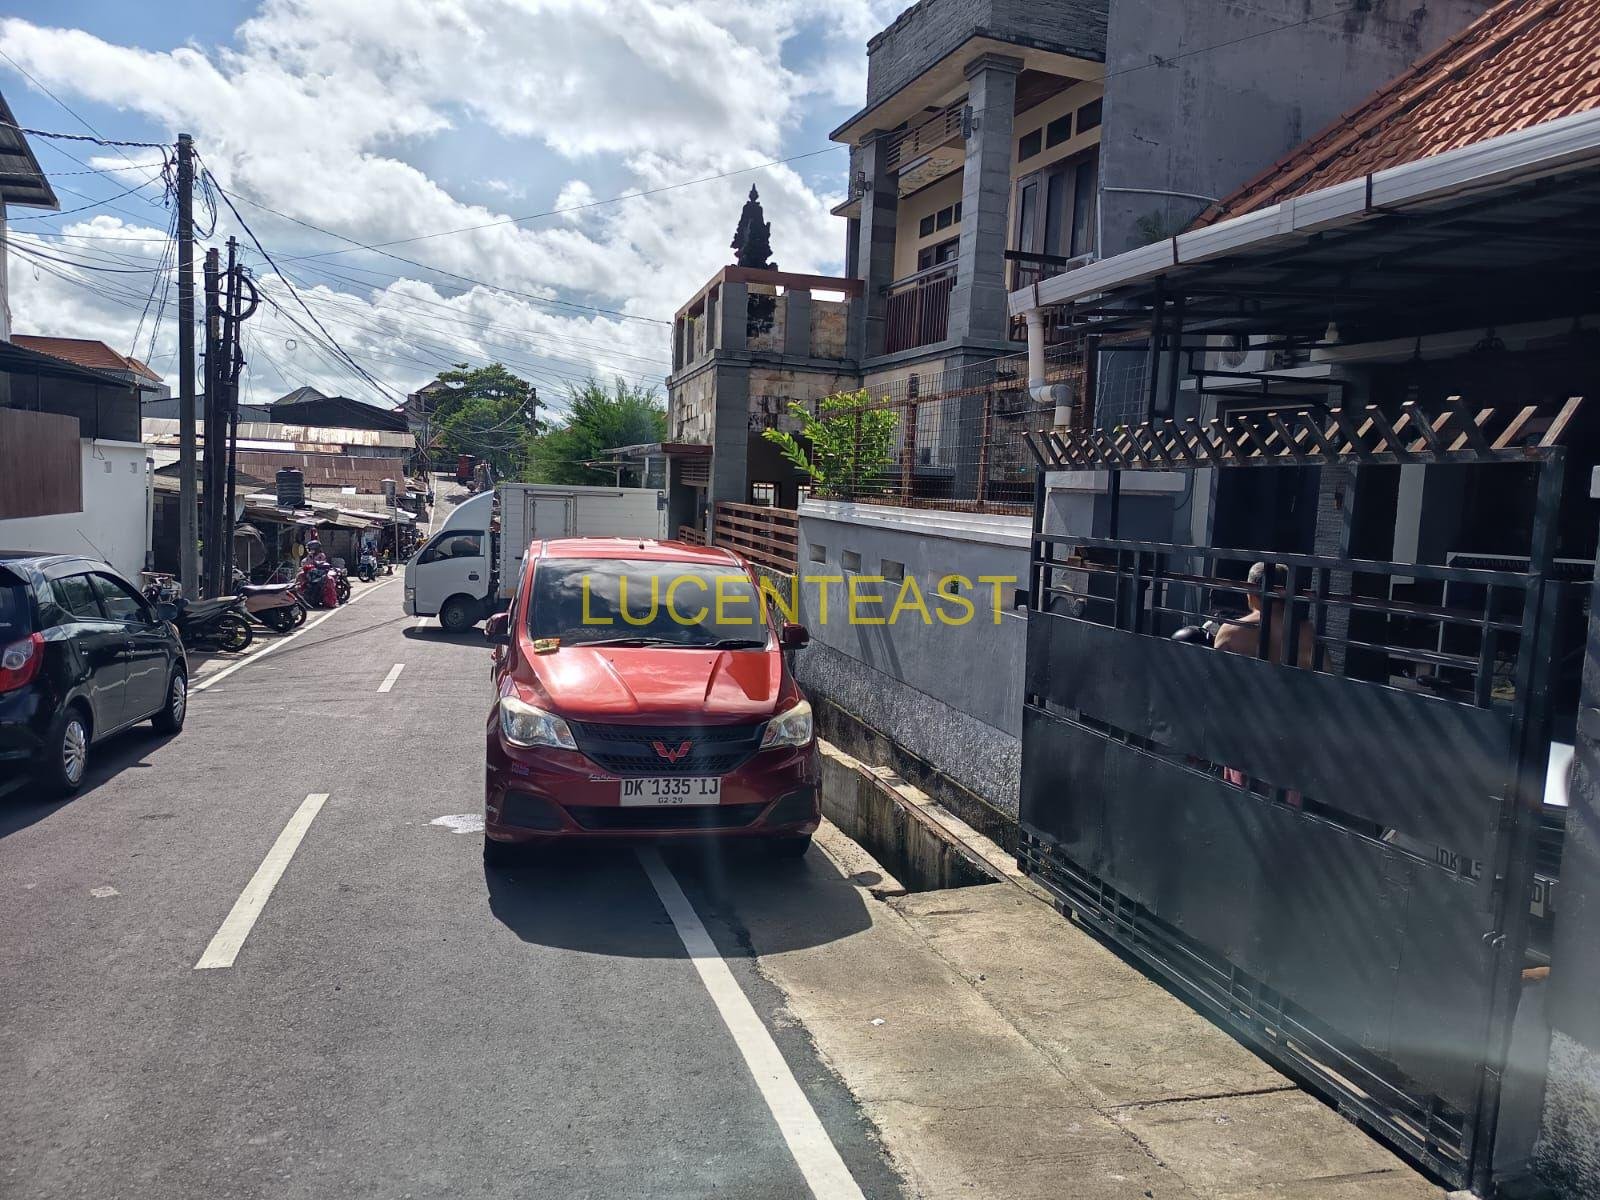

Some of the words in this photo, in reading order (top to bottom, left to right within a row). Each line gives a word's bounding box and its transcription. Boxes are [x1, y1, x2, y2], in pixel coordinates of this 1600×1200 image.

[624, 780, 642, 796] DK
[651, 779, 690, 796] 1335
[699, 779, 718, 795] IJ
